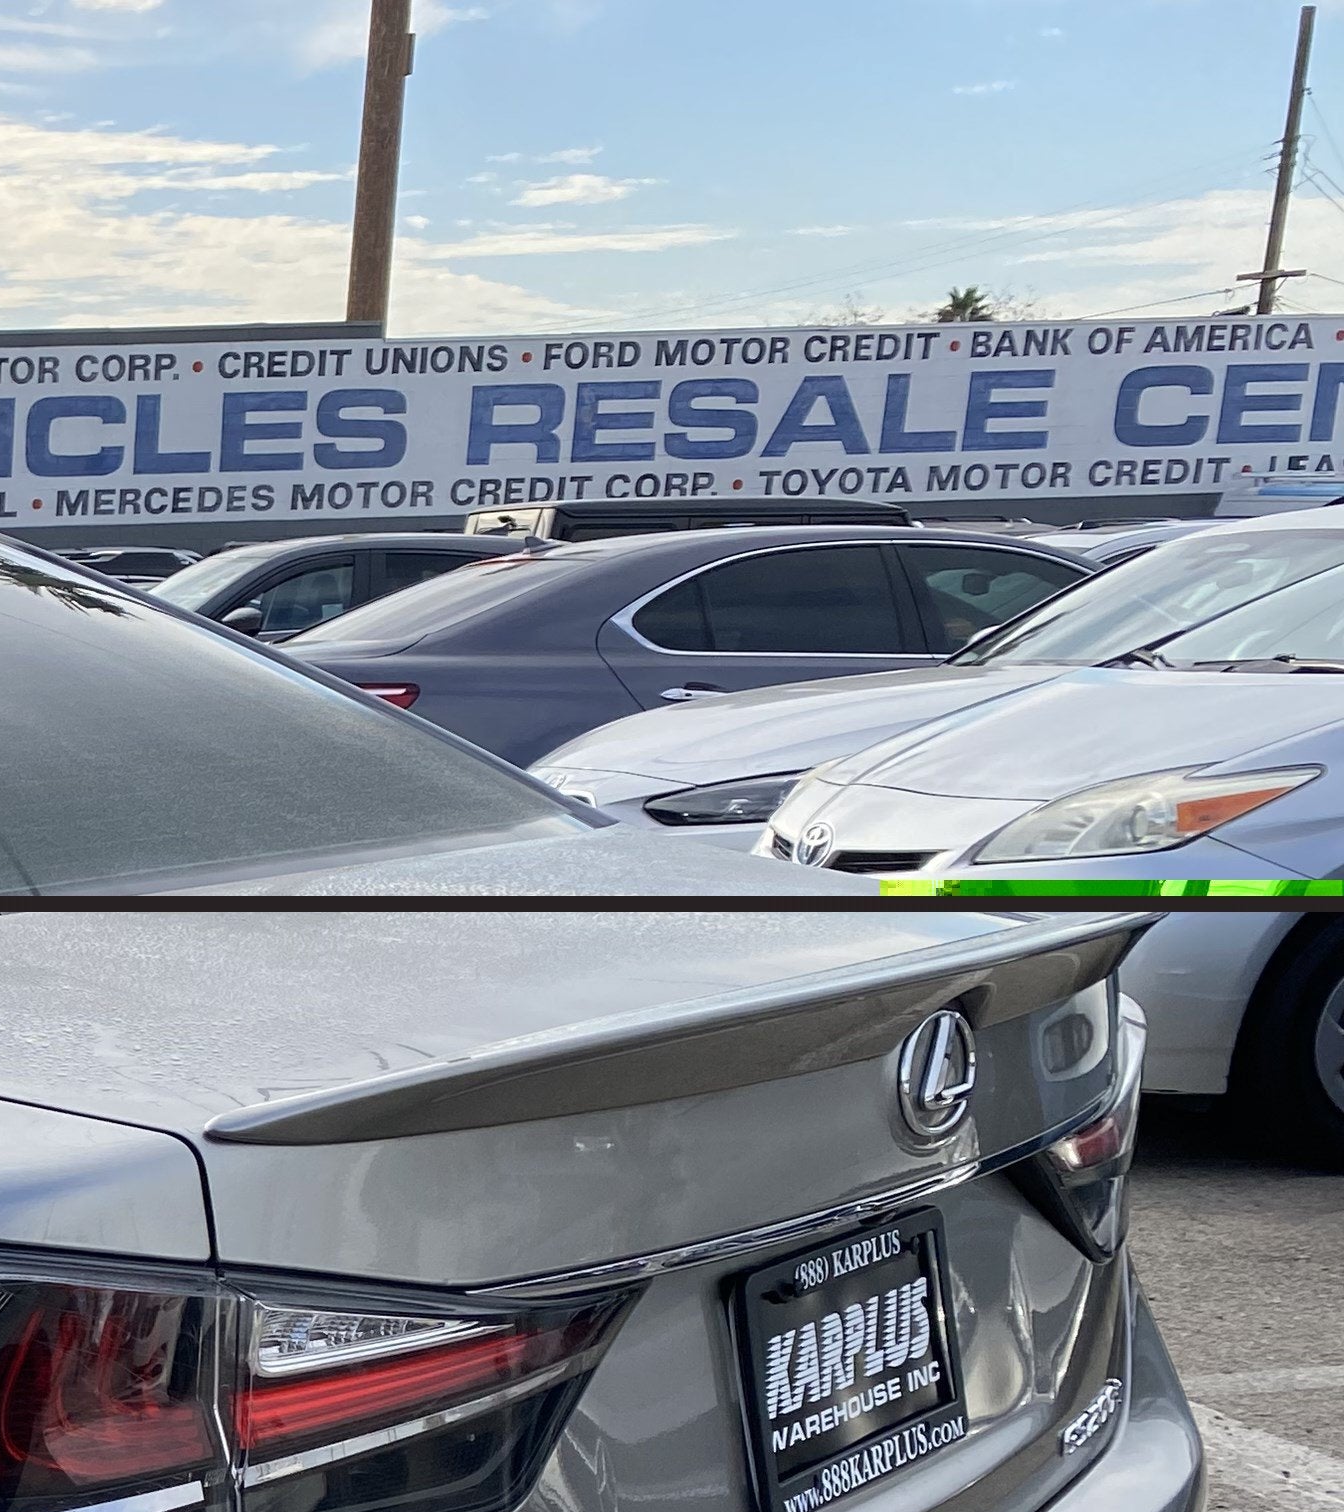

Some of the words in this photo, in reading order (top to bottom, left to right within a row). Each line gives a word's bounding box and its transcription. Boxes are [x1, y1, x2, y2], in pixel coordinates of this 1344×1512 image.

[543, 340, 642, 370] FORD
[654, 336, 791, 367] MOTOR
[803, 332, 940, 363] CREDIT
[970, 327, 1074, 358] BANK
[1088, 326, 1135, 355] OF
[1143, 323, 1314, 354] AMERICA
[75, 352, 180, 383] CORP.
[218, 348, 353, 379] CREDIT
[365, 344, 509, 375] UNIONS
[467, 369, 1056, 466] RESALE
[56, 484, 275, 517] MERCEDES
[290, 479, 434, 512] MOTOR
[450, 475, 593, 506] CREDIT
[606, 471, 717, 499] CORP.
[759, 466, 912, 496] TOYOTA
[926, 462, 1072, 492] MOTOR
[1088, 457, 1231, 487] CREDIT
[795, 1255, 828, 1290] (888)
[832, 1229, 900, 1278] KARPLUS
[765, 1277, 930, 1420] KARPLUS
[907, 1360, 941, 1392] INC
